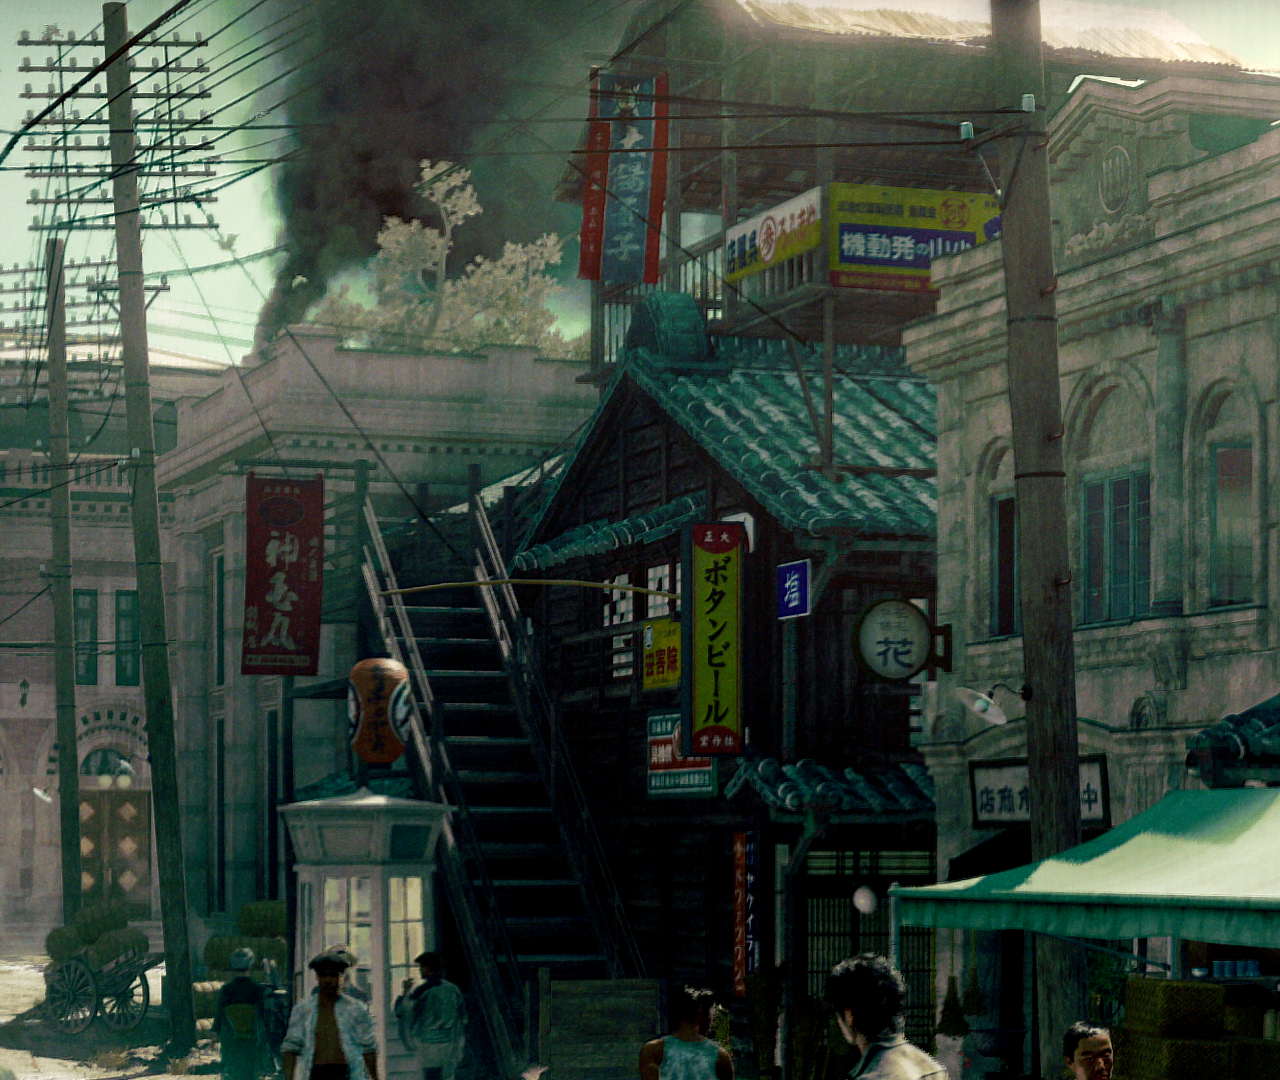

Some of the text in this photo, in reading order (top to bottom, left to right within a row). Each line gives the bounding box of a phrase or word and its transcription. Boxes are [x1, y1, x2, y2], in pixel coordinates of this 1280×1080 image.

[703, 530, 730, 544] 大正
[784, 570, 802, 608] 塩
[703, 555, 732, 724] ボタンビール
[875, 637, 915, 668] 花
